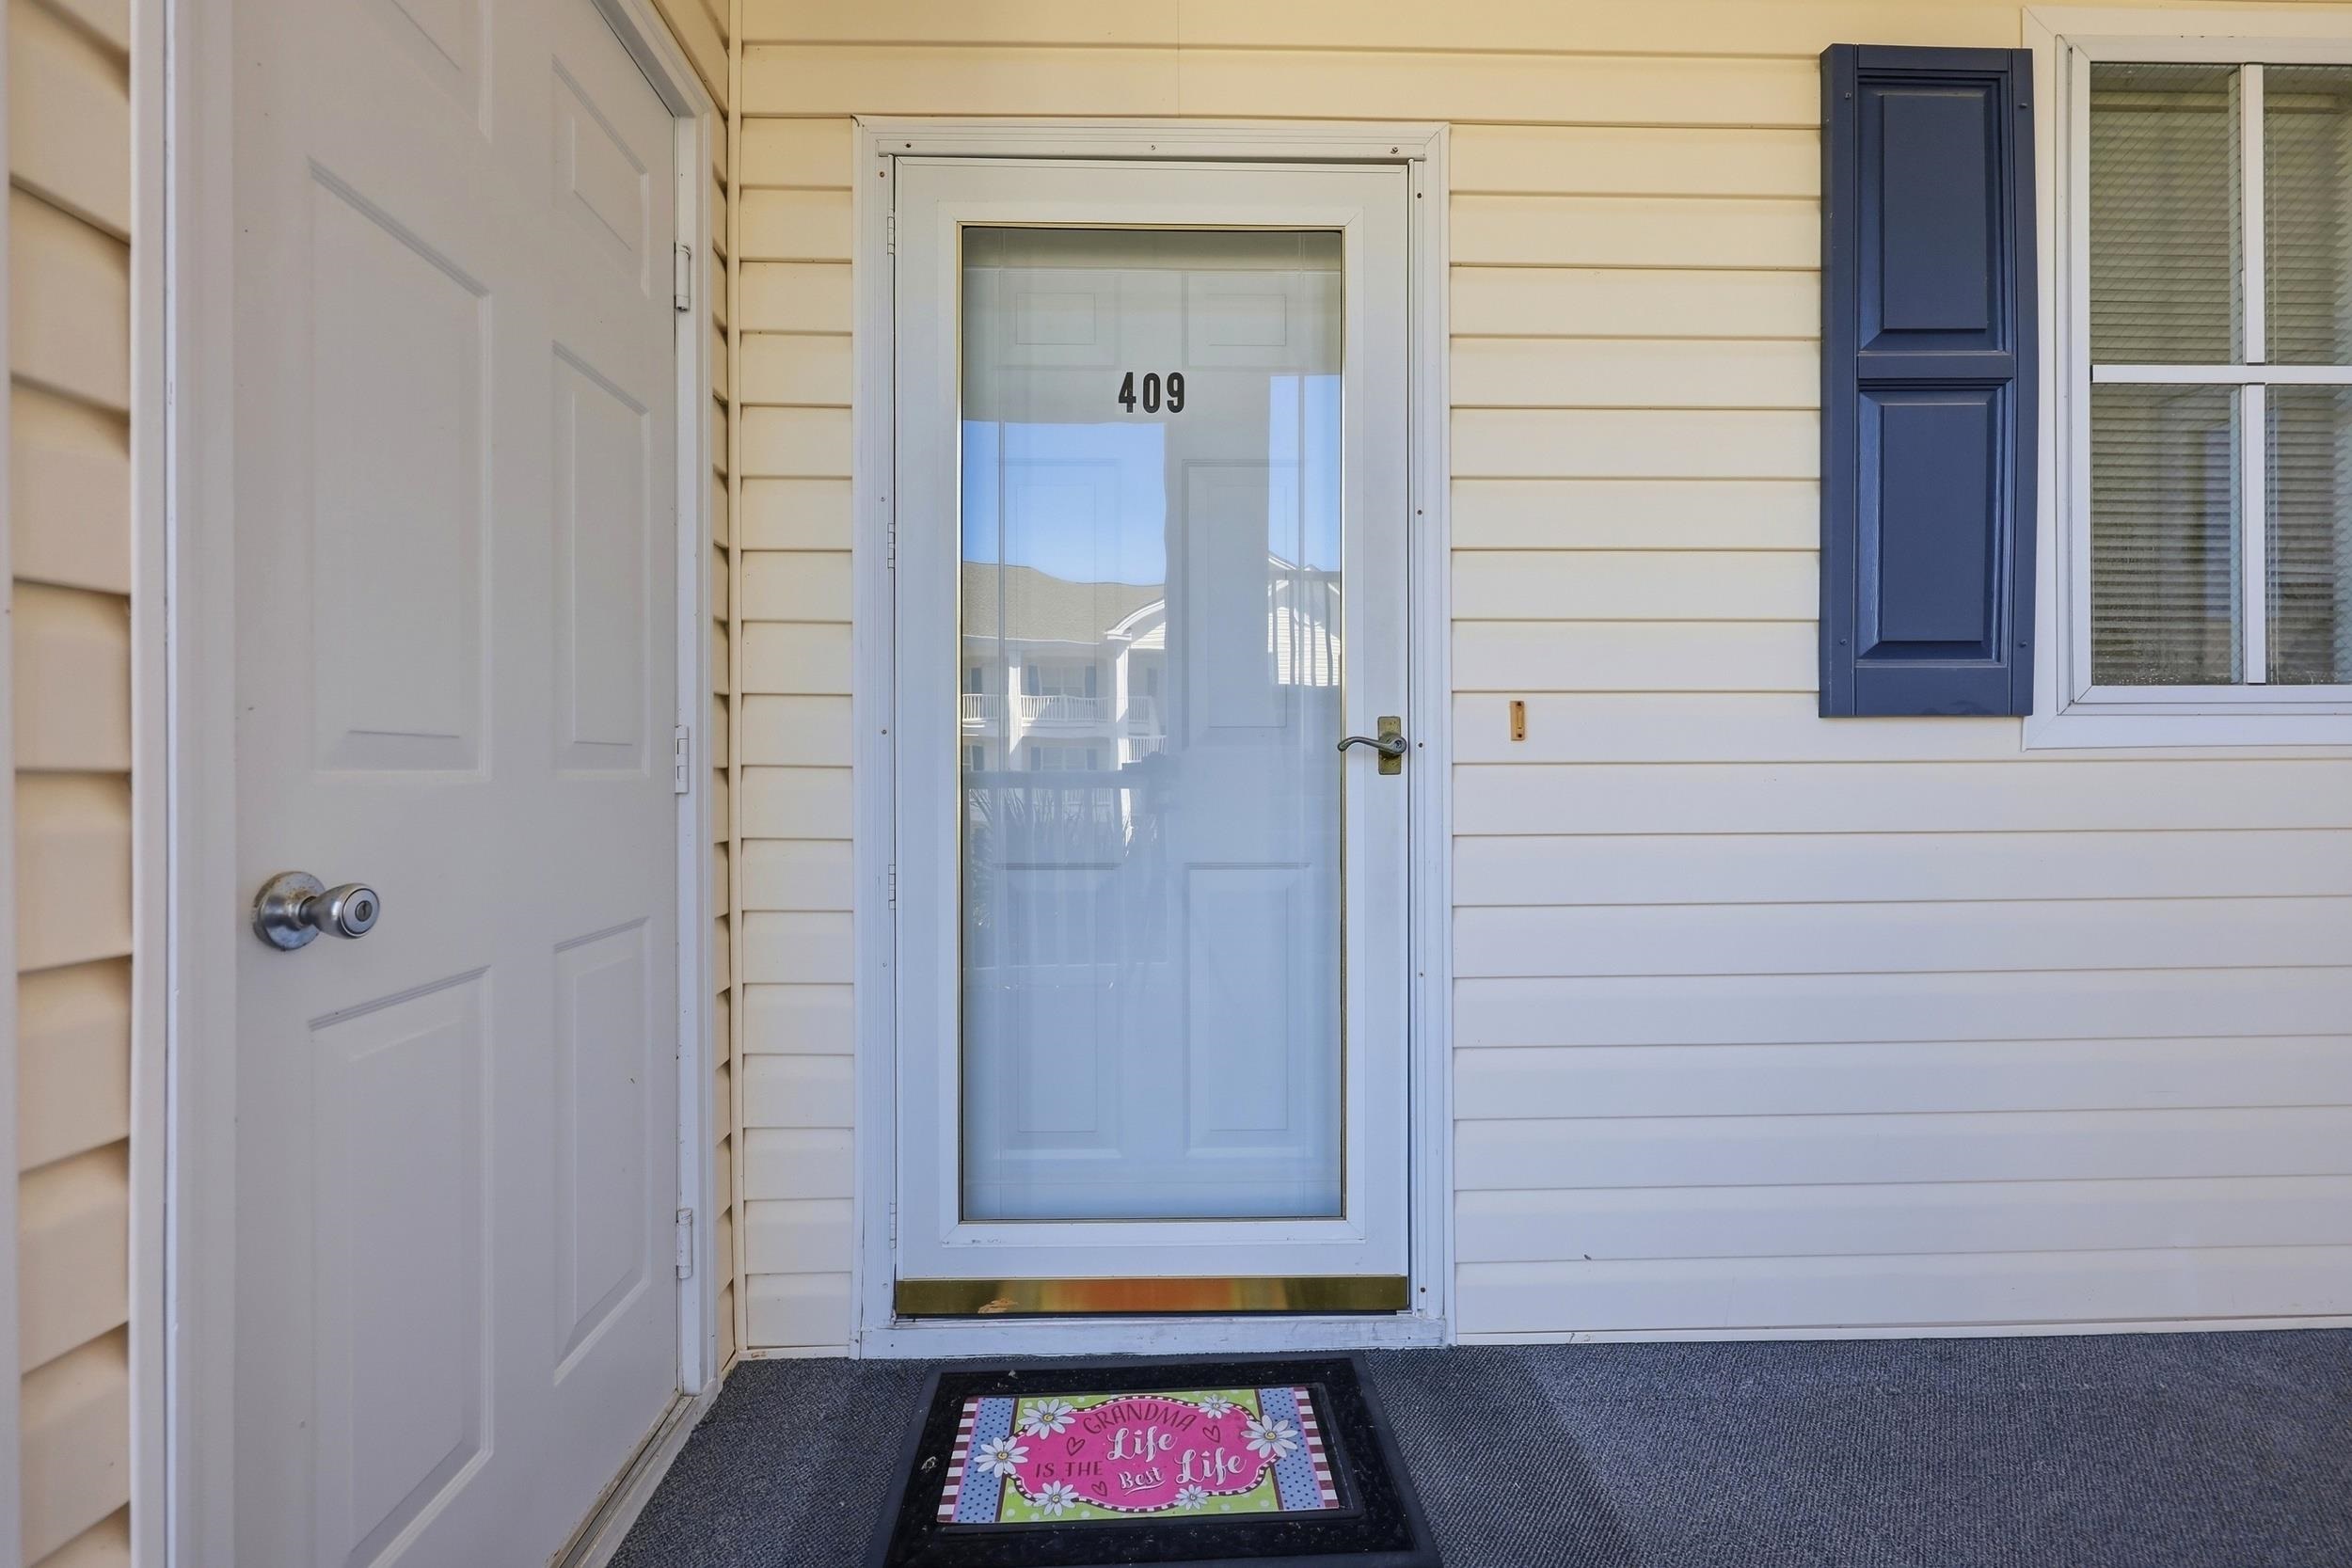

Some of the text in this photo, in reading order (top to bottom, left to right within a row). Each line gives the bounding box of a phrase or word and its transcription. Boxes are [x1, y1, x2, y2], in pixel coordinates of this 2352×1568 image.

[1118, 372, 1185, 414] 409
[1083, 1402, 1197, 1433] GRANDMA
[1106, 1425, 1177, 1463] Life
[1035, 1461, 1104, 1479] IS THE
[1118, 1466, 1165, 1489] Best
[1175, 1448, 1248, 1486] Life
